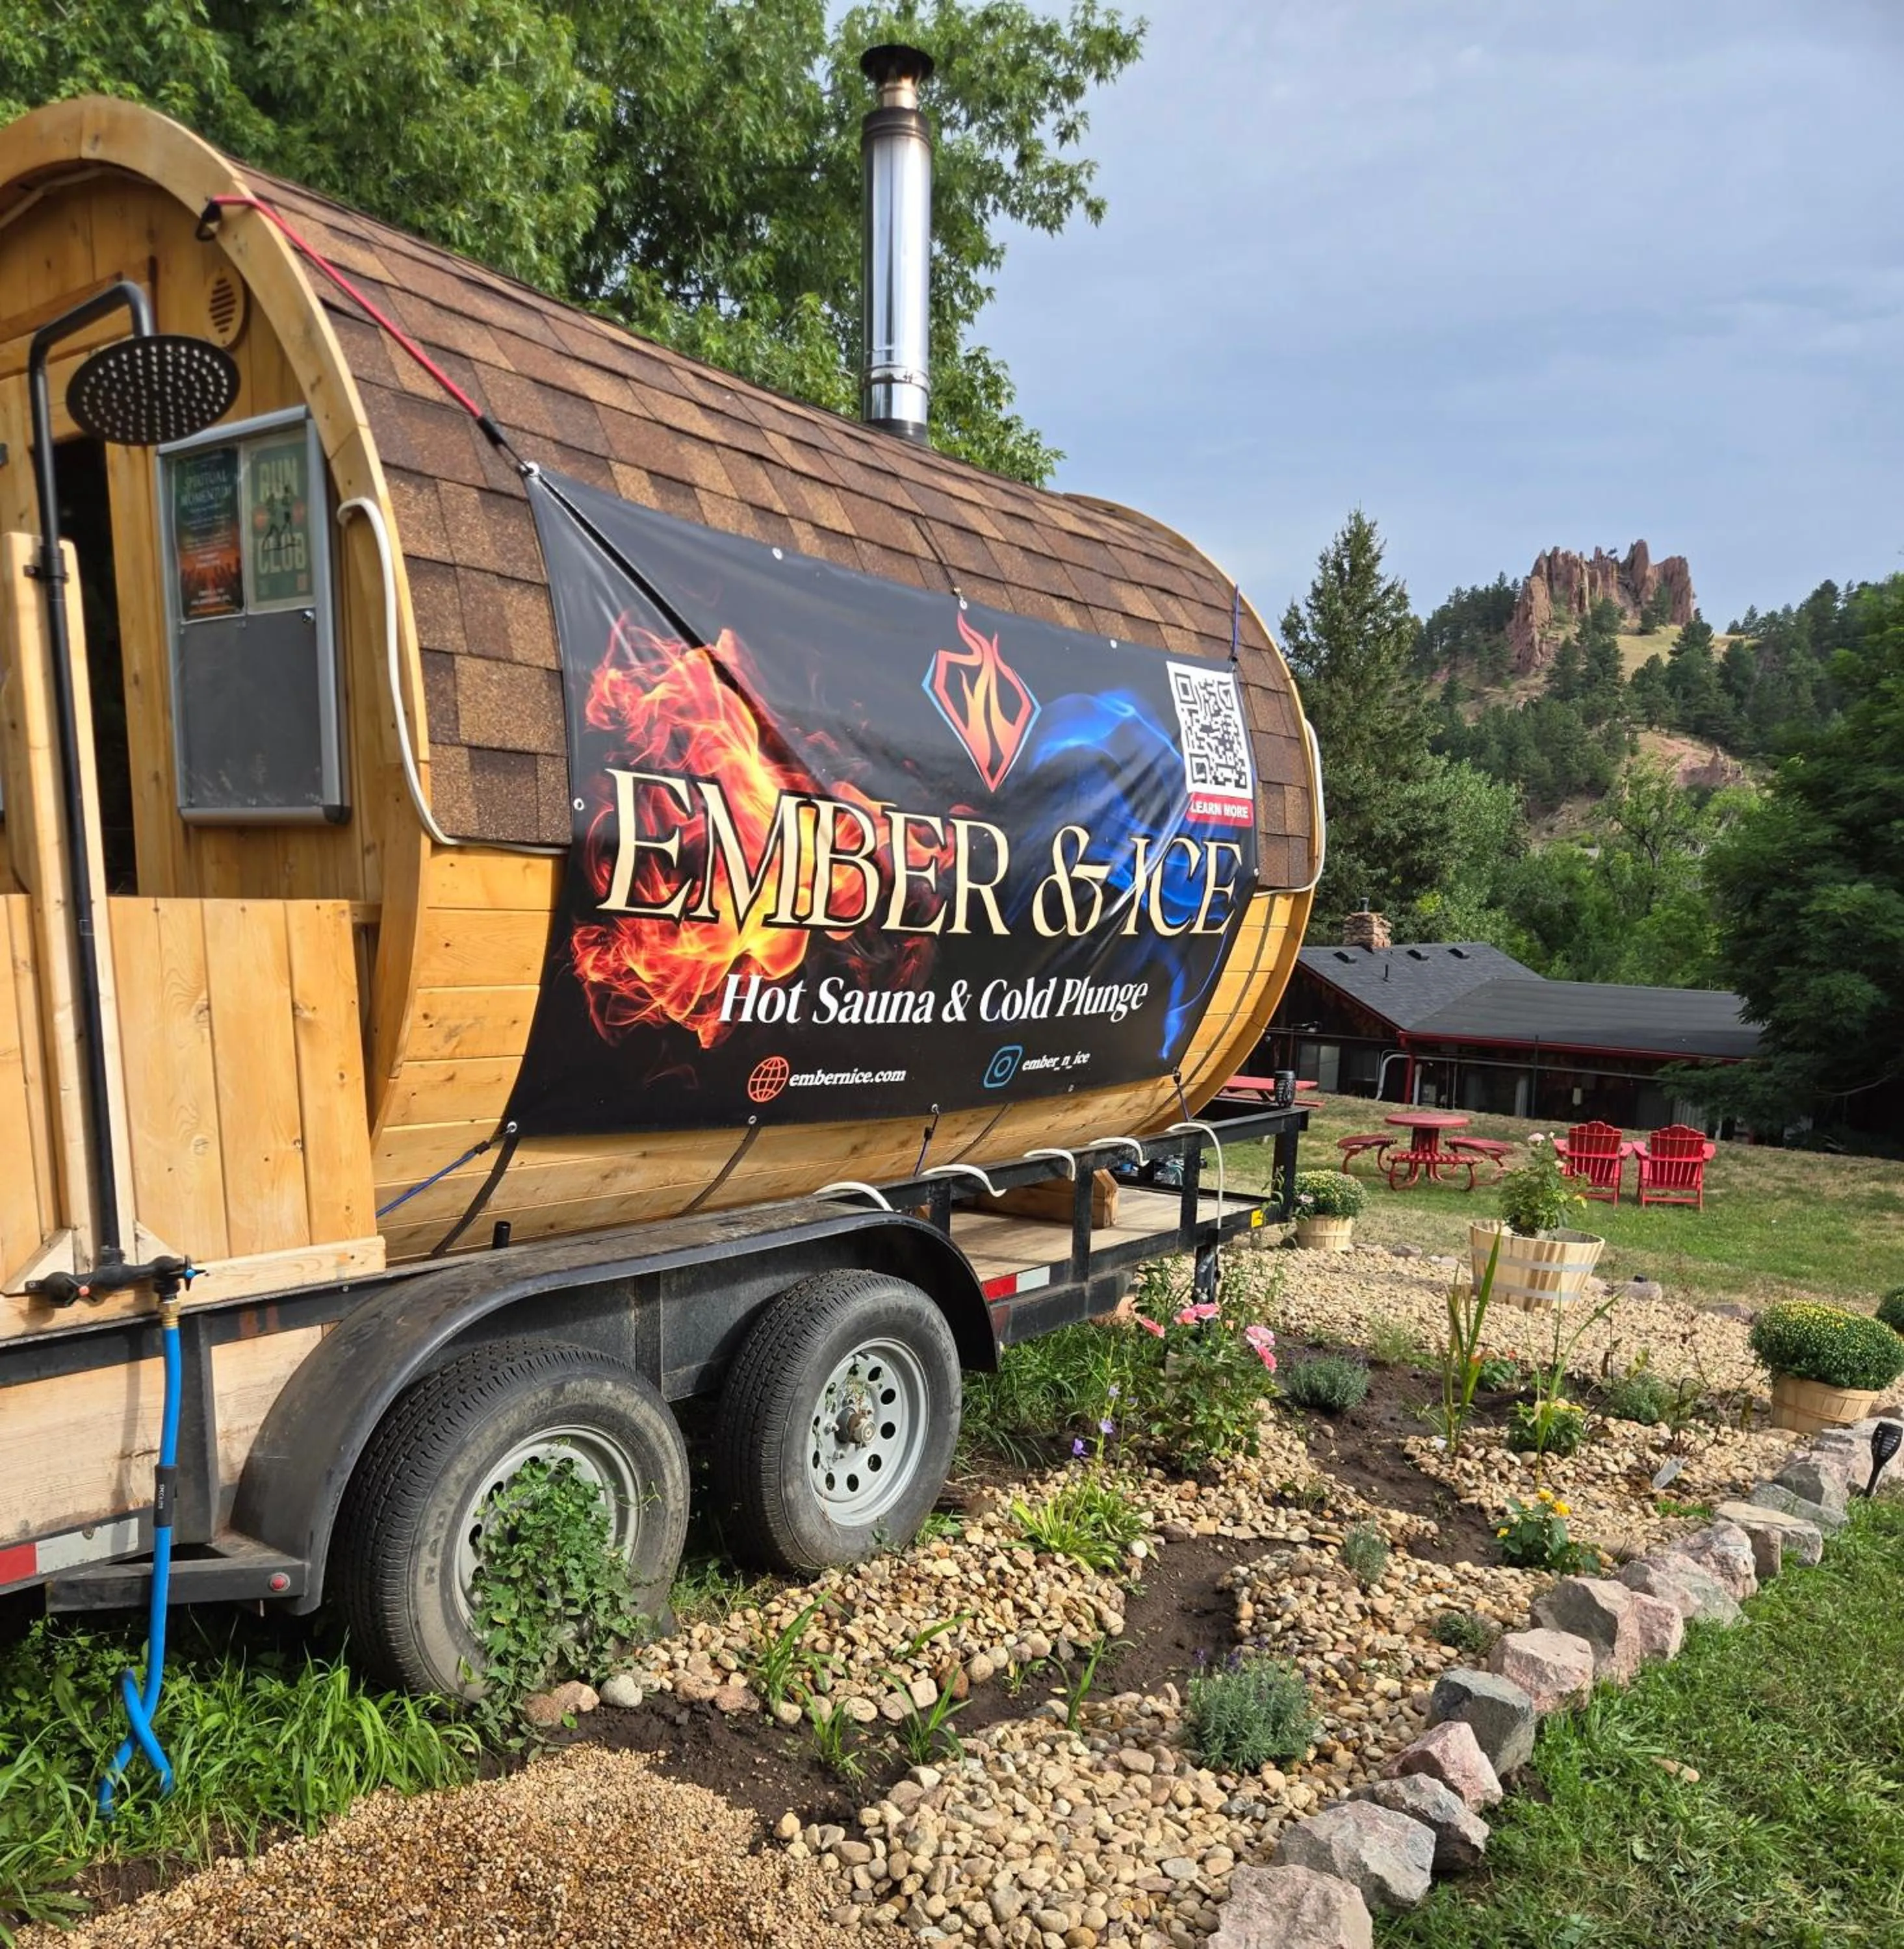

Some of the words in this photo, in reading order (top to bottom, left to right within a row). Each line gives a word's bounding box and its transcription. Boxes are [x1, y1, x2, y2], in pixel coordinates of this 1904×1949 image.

[258, 457, 299, 502] RUN
[258, 531, 307, 575] CLUB
[1190, 801, 1222, 815] LEARN
[1223, 804, 1249, 819] MORE
[596, 768, 1012, 936] EMBER
[1032, 826, 1111, 938] &
[1119, 836, 1242, 937] ICE
[717, 973, 807, 1024] Hot
[812, 976, 936, 1024] Sauna
[942, 979, 972, 1023] &
[979, 976, 1057, 1022] Cold
[1055, 975, 1149, 1023] Plunge
[789, 1068, 907, 1087] embernice.com
[1022, 1051, 1091, 1071] ember_n_ice
